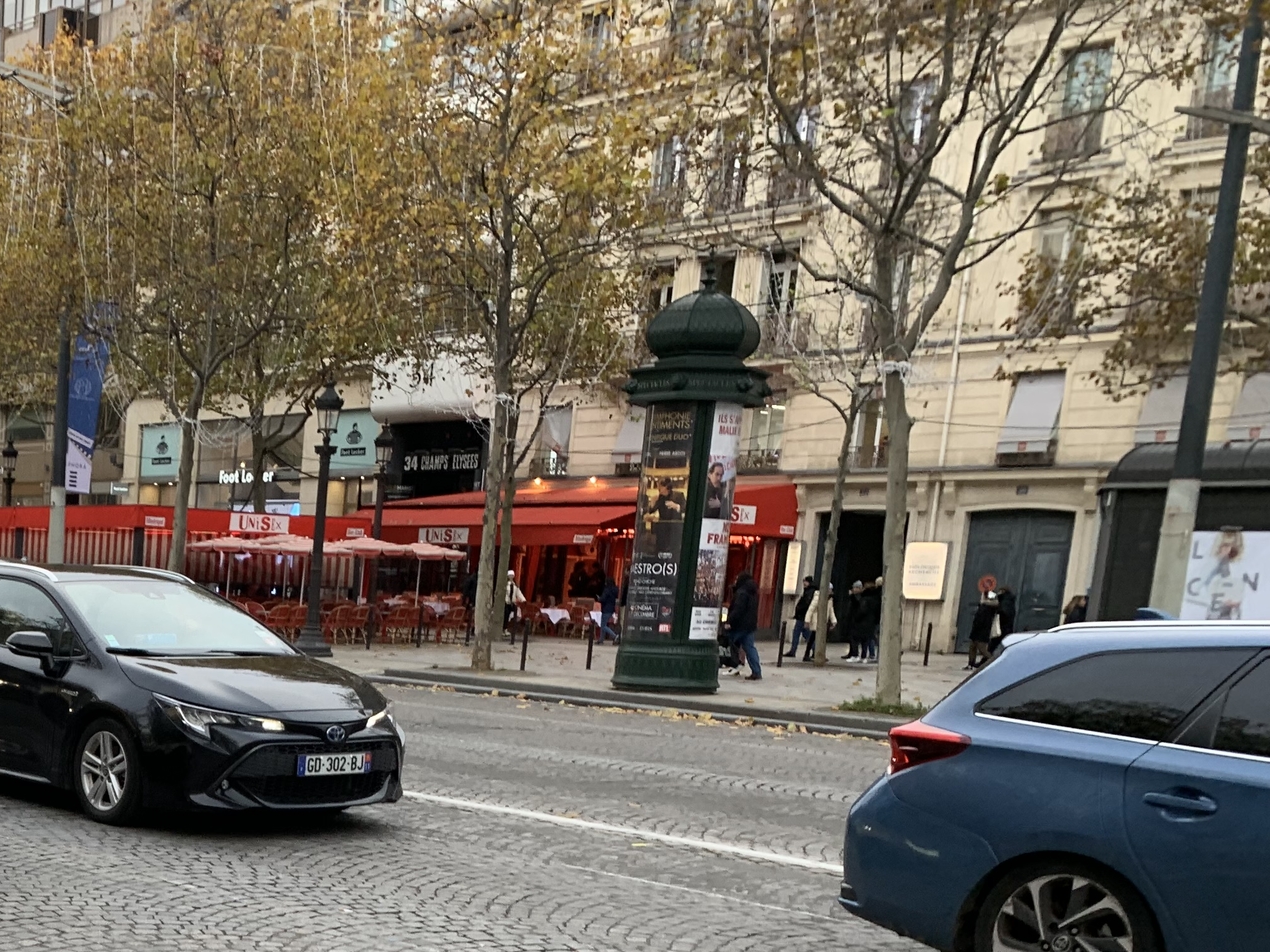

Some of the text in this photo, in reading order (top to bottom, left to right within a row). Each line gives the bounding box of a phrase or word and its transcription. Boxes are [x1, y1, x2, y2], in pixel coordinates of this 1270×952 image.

[404, 453, 479, 471] 34 CHAMPS ELYSEES
[219, 469, 274, 484] Foot Loer
